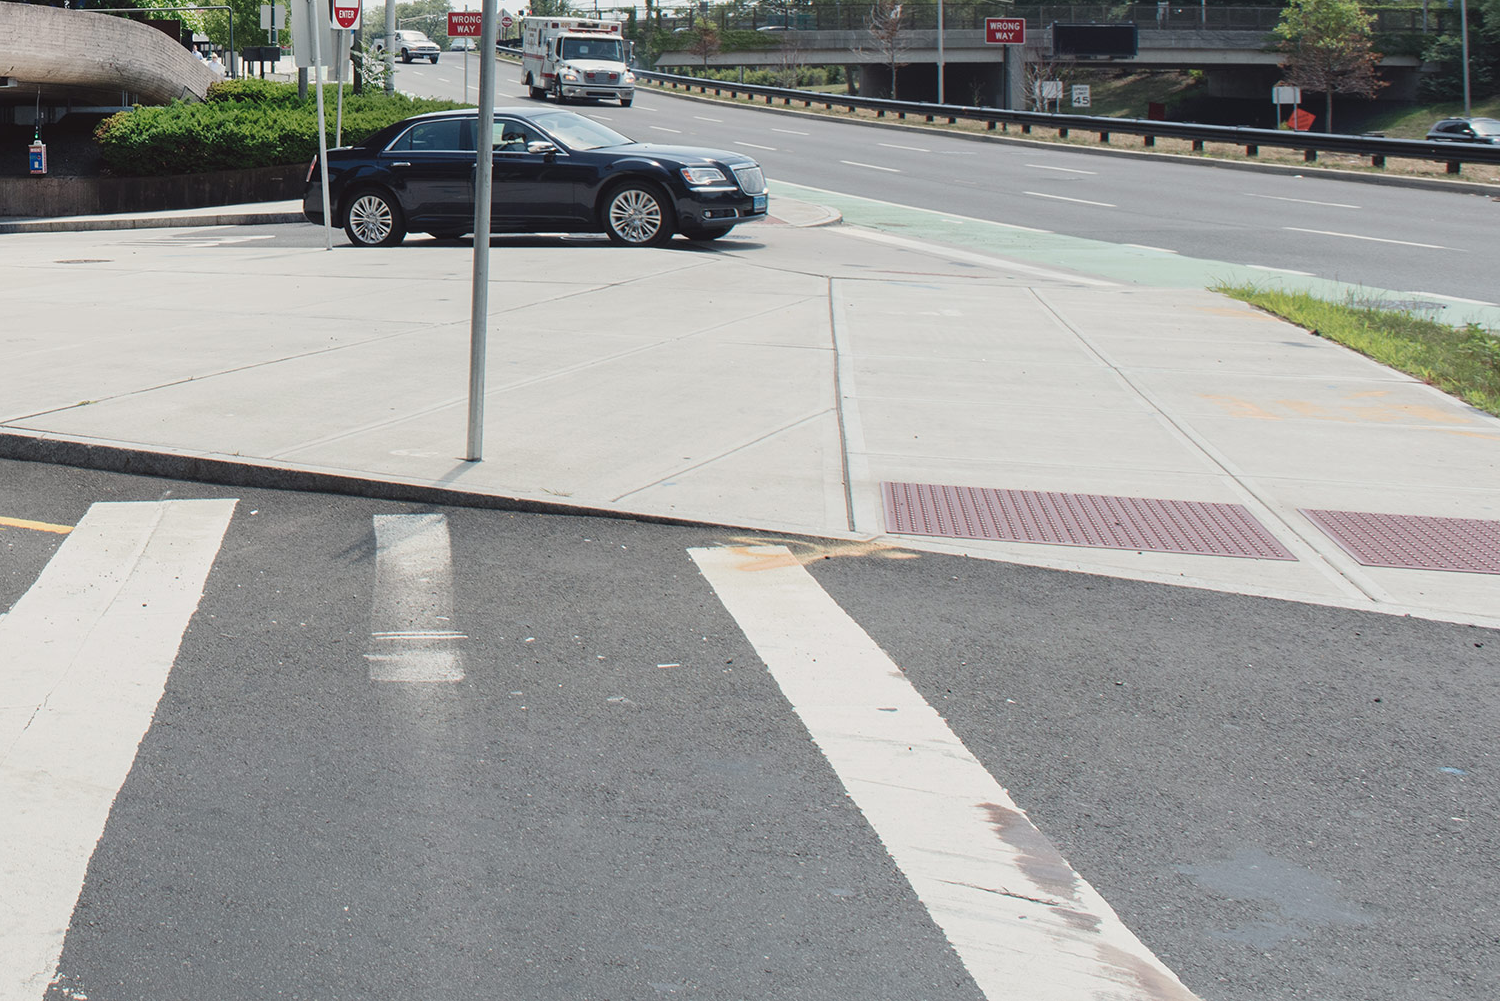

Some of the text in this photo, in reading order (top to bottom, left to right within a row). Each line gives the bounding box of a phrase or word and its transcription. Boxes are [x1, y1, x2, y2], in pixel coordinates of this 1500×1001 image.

[338, 9, 355, 19] ENTER
[451, 15, 482, 24] WRONG
[457, 25, 475, 33] WAY
[990, 22, 1020, 31] WRONG
[995, 32, 1014, 40] WAY
[1073, 96, 1090, 105] 45
